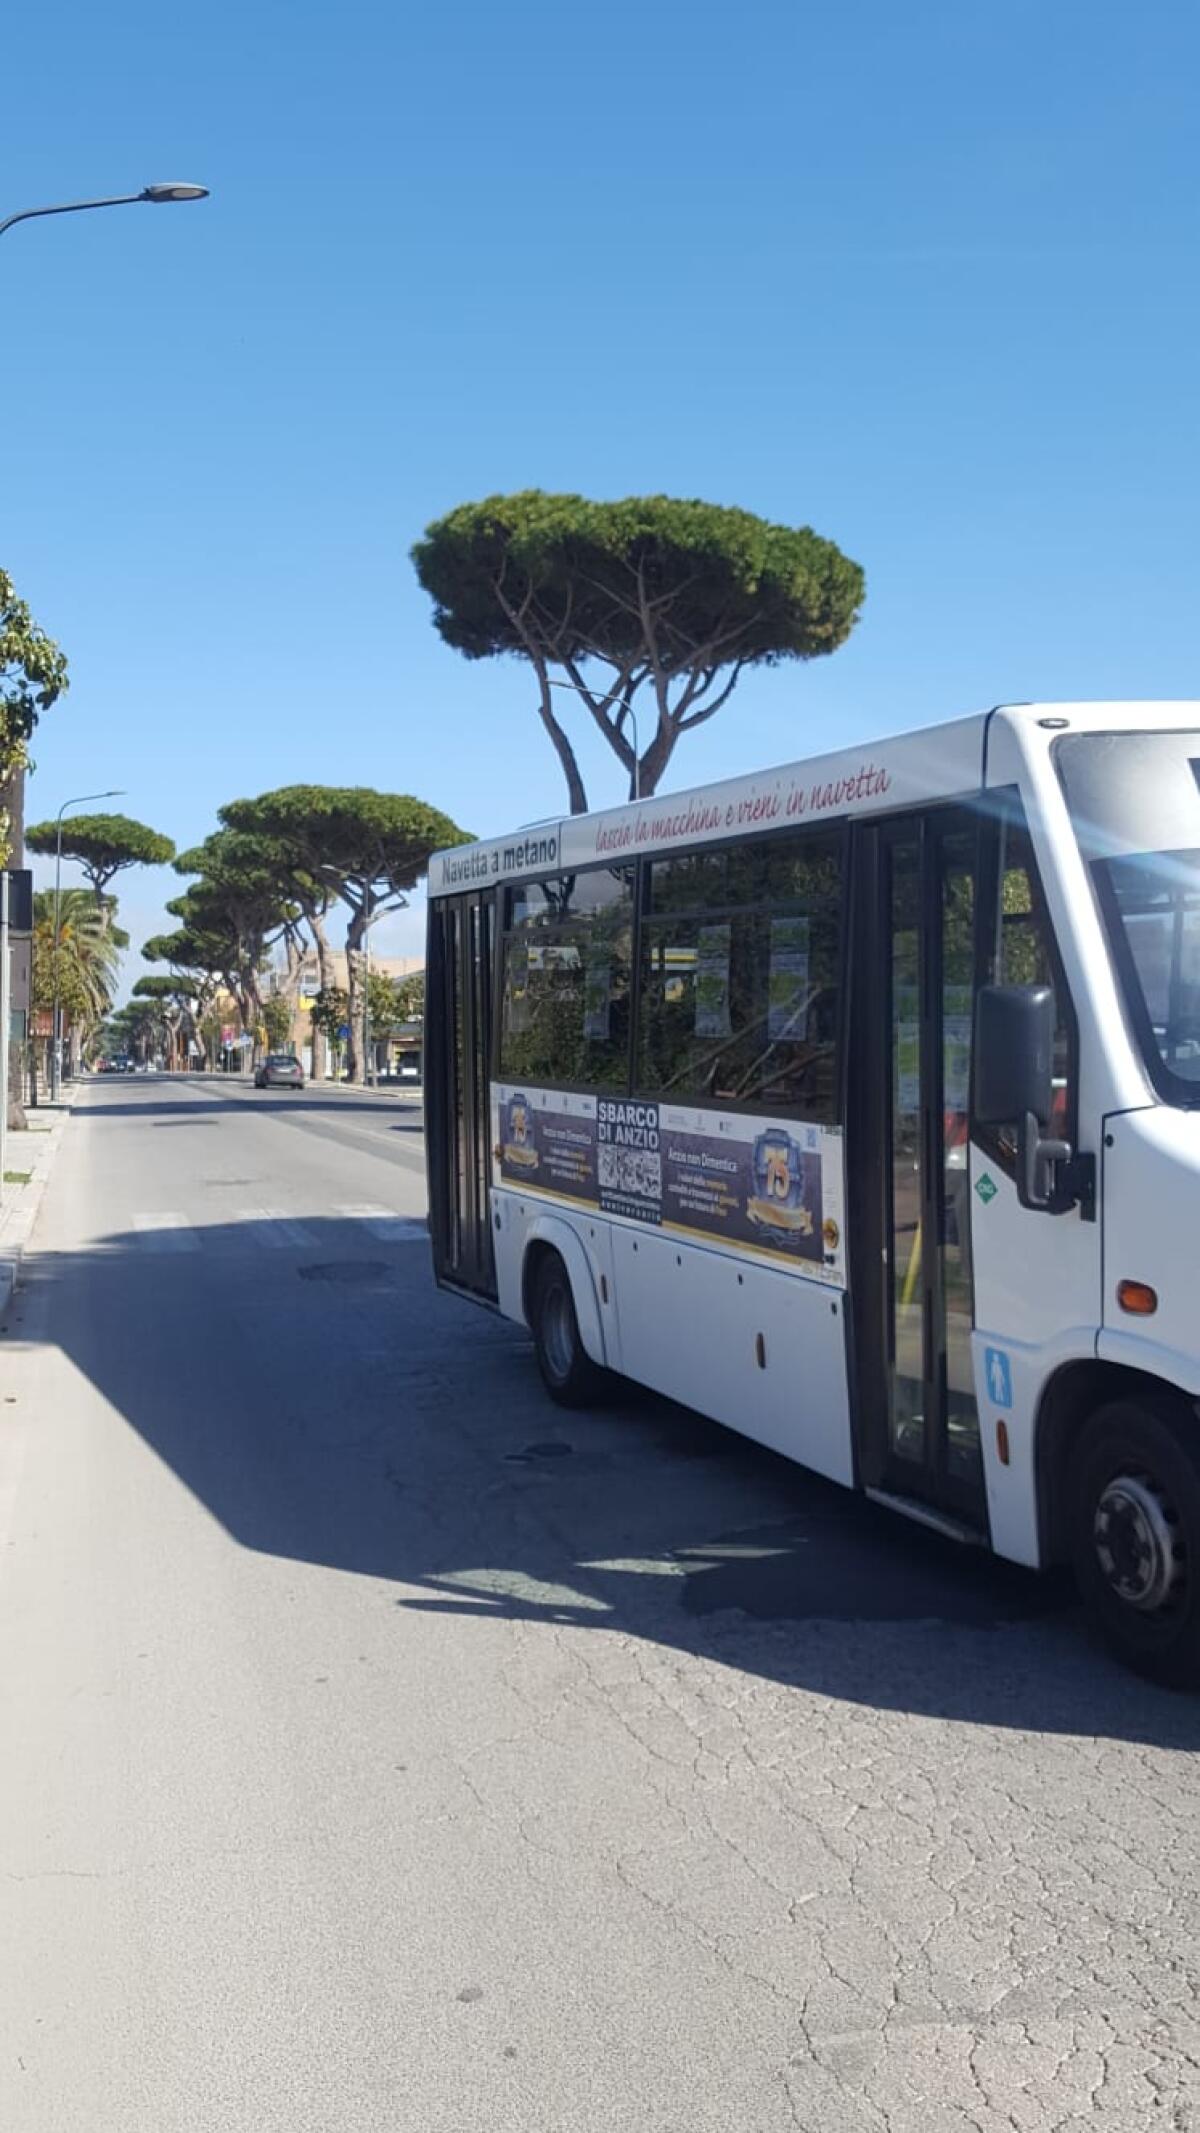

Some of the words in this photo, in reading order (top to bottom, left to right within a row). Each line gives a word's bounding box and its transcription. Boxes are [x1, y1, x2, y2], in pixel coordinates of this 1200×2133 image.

[634, 809, 648, 842] la
[651, 800, 721, 840] macchina
[725, 804, 735, 827] e
[738, 780, 780, 824] vieni
[786, 778, 806, 817] in
[810, 763, 892, 810] navetta
[442, 848, 488, 886] Navetta
[491, 849, 499, 873] a
[503, 837, 557, 870] metano
[598, 1102, 658, 1129] SBARCO
[598, 1122, 611, 1142] DI
[614, 1125, 659, 1150] ANZIO
